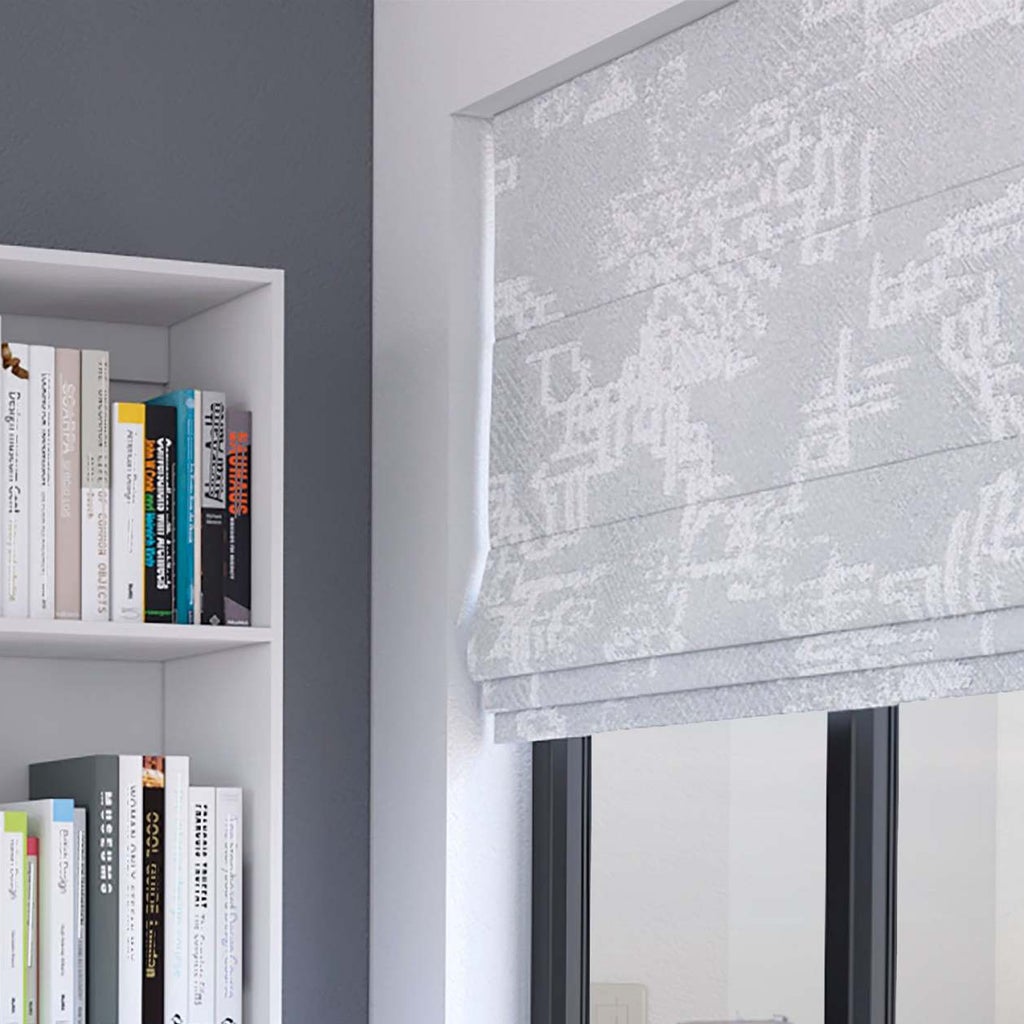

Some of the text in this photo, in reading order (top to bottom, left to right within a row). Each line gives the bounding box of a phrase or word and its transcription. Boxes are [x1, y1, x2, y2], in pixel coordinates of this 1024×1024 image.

[228, 431, 248, 515] BAUHAUS
[156, 438, 172, 590] Conversations with Architects
[97, 563, 107, 614] OBJECTS
[100, 791, 113, 894] MUSEUMS
[146, 812, 159, 858] COOL
[146, 864, 159, 914] GUIDE
